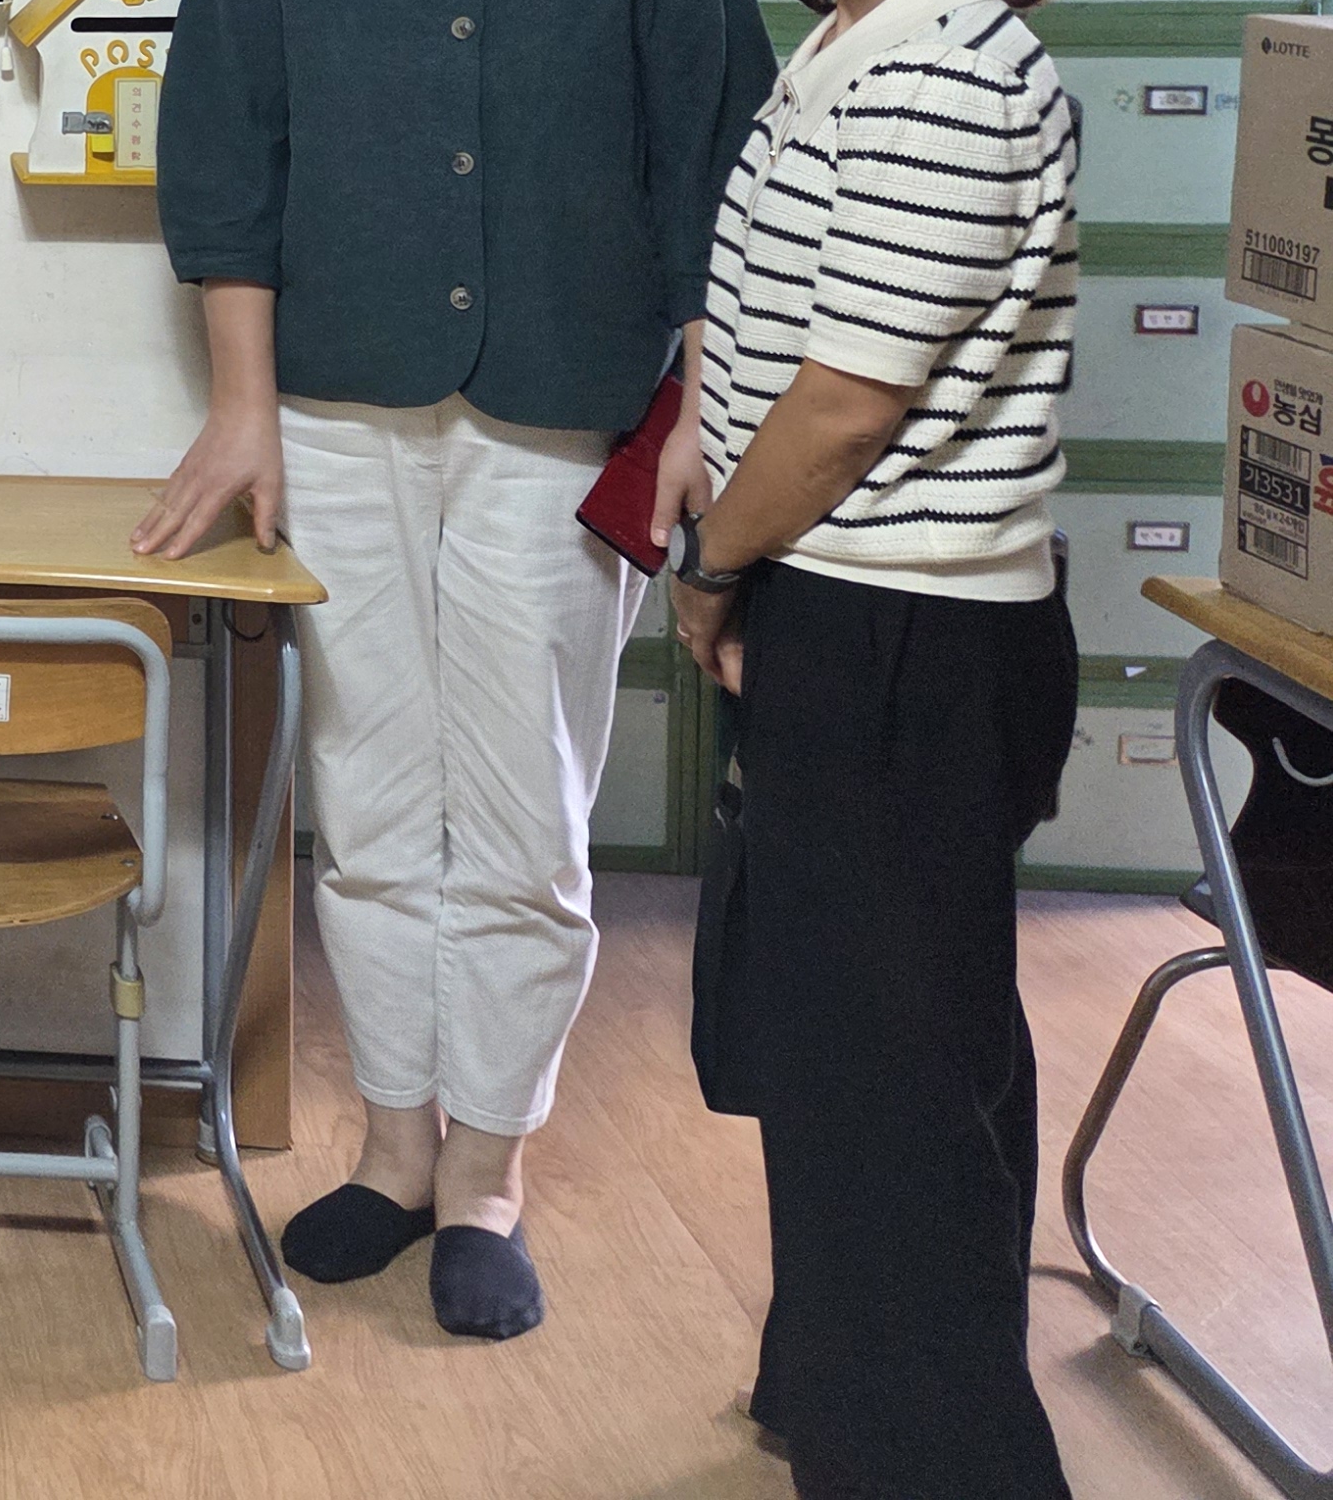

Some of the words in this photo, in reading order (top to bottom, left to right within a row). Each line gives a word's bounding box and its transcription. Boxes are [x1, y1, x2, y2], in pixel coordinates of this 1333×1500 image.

[80, 39, 171, 78] POS
[1273, 41, 1310, 59] LOTTE
[1245, 229, 1320, 264] 511003197
[1272, 393, 1322, 436] 농심
[1244, 465, 1308, 511] 가3531
